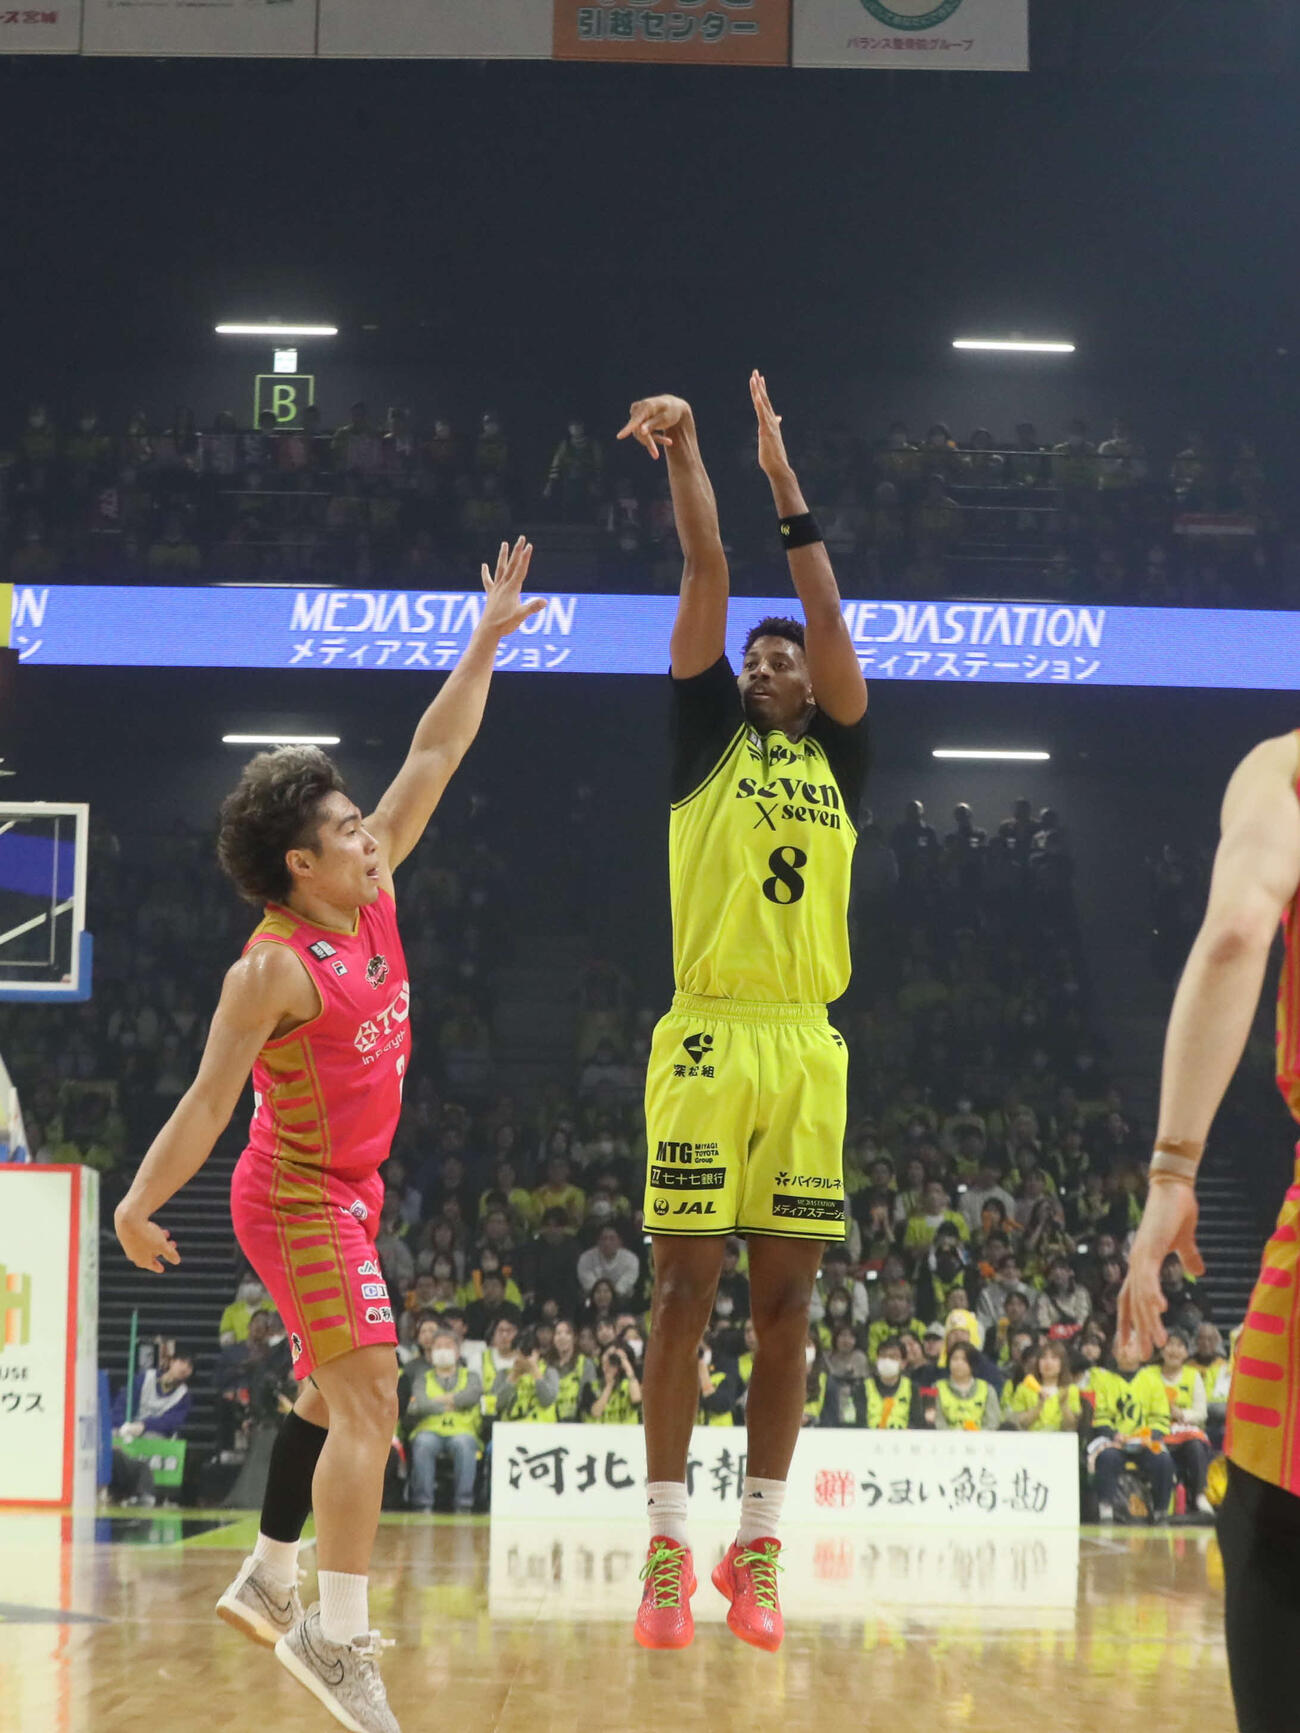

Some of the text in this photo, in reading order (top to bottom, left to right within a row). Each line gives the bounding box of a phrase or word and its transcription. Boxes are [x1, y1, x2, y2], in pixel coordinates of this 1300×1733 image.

[579, 8, 758, 42] 引越センター
[273, 384, 297, 422] B
[290, 592, 577, 636] MEDIASTAON
[289, 637, 571, 668] メディアステション
[854, 649, 1101, 680] ディアステーション
[736, 777, 840, 810] seven
[781, 804, 841, 830] seven
[762, 845, 807, 905] 8
[695, 1142, 718, 1150] MIYAGI
[662, 1172, 724, 1185] 七十七銀行
[672, 1201, 717, 1215] JAL
